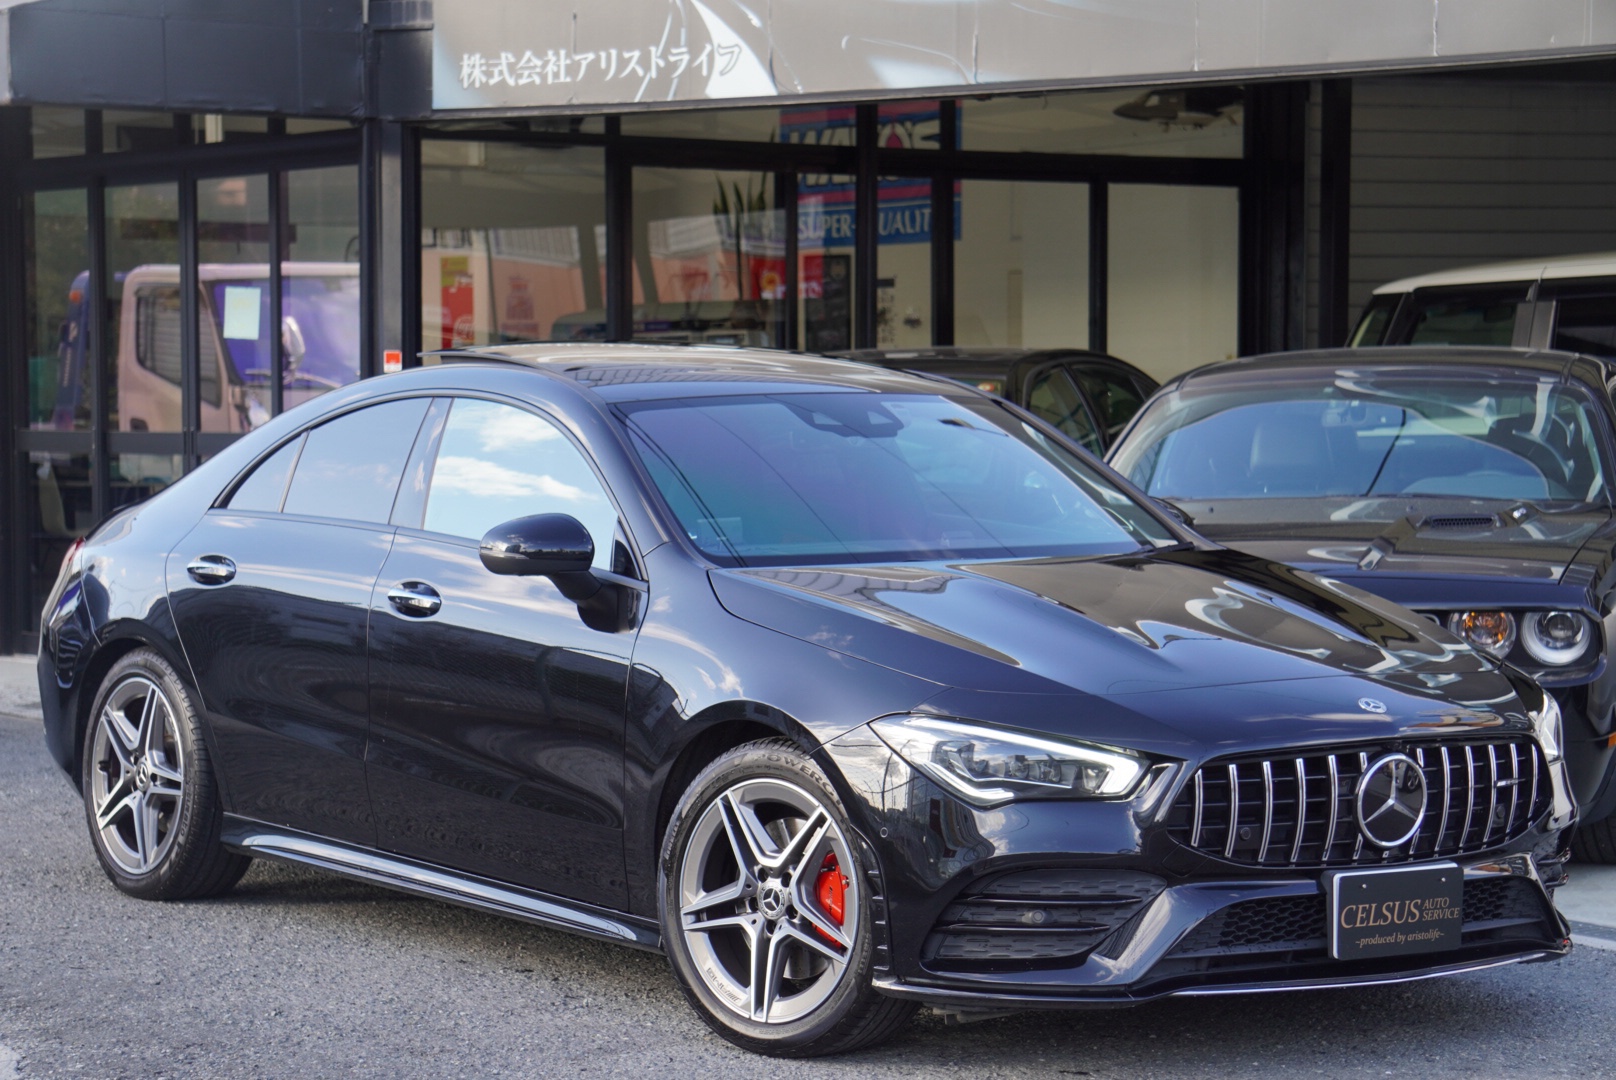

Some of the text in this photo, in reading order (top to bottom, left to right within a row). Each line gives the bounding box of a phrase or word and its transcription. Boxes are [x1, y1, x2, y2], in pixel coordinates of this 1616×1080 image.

[460, 43, 743, 89] 株式会社アリストライフ
[785, 117, 943, 187] WAO'S
[799, 207, 933, 241] SUPER-UALIT
[1340, 899, 1421, 929] CELSUS
[1422, 908, 1460, 922] SERVICE
[1423, 897, 1449, 909] AUTO
[1397, 930, 1406, 944] by
